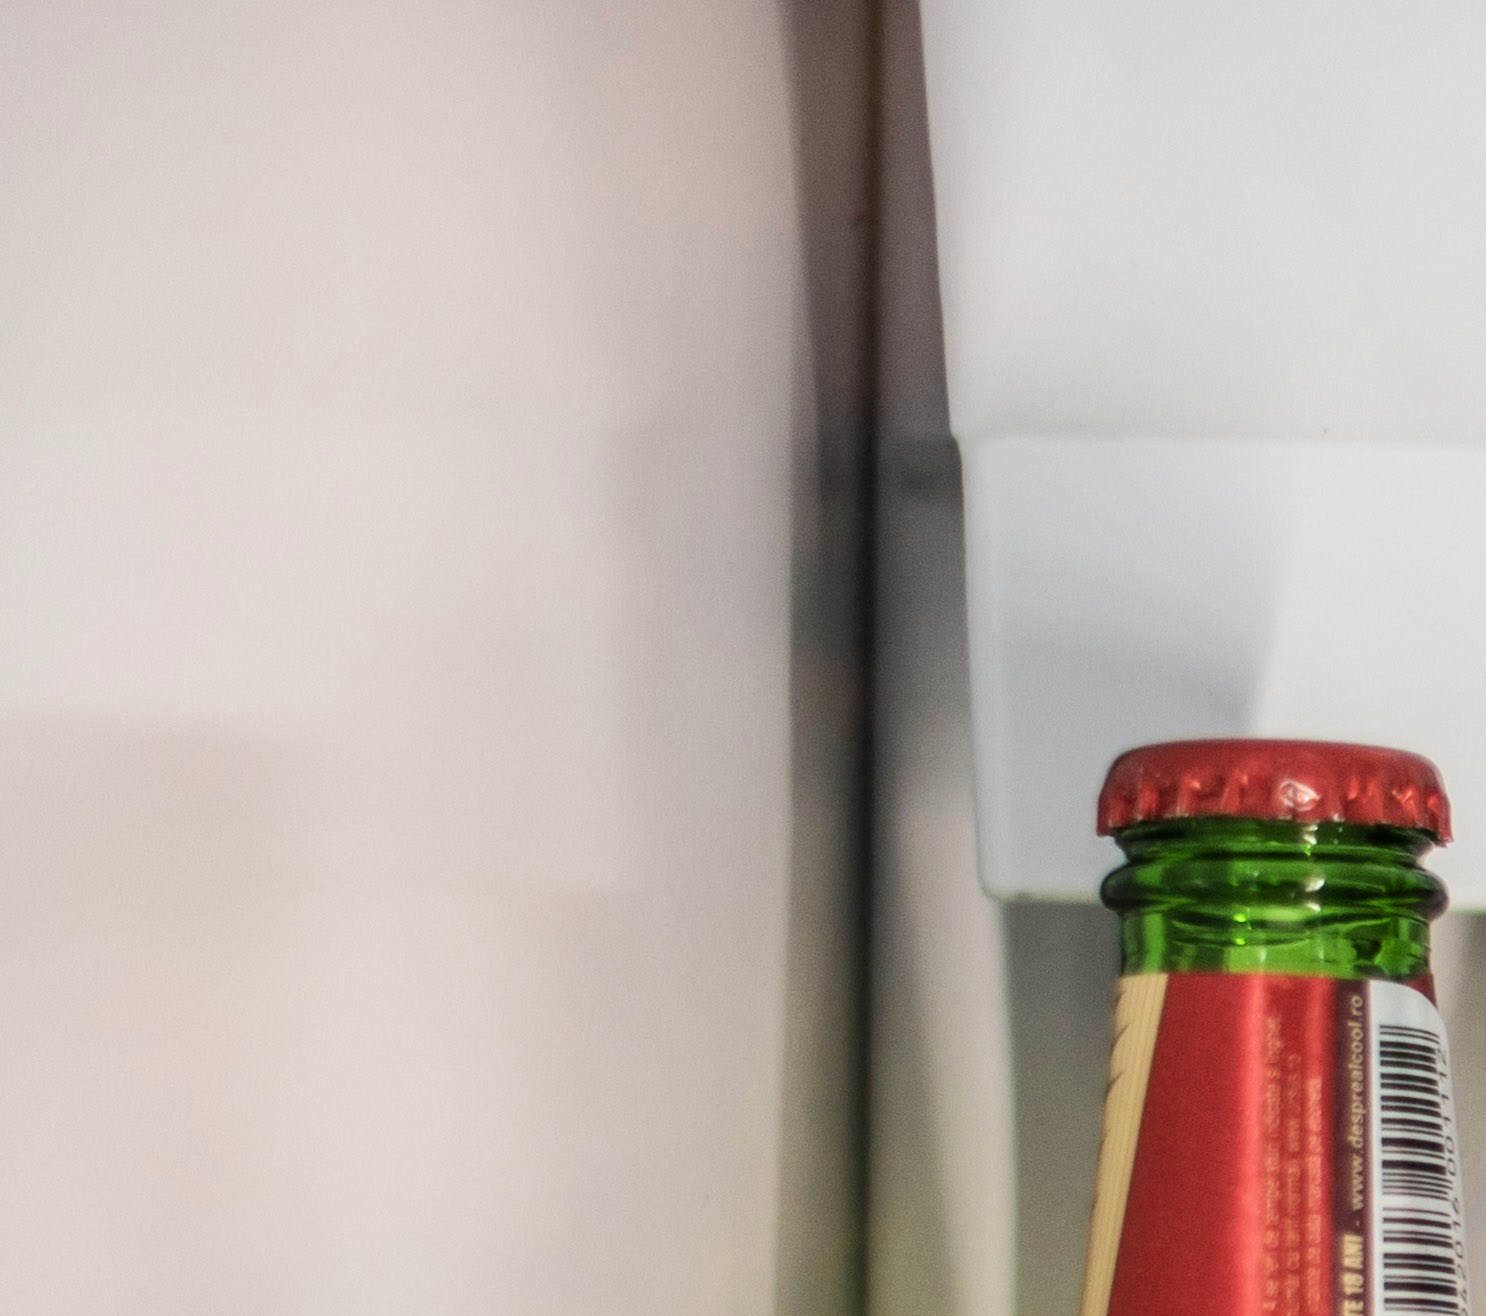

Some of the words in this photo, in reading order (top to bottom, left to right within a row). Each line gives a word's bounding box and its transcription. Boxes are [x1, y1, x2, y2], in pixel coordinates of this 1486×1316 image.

[1348, 995, 1366, 1210] www.desprealcool.ro
[1343, 1233, 1363, 1268] ANI
[1343, 1272, 1363, 1294] 18
